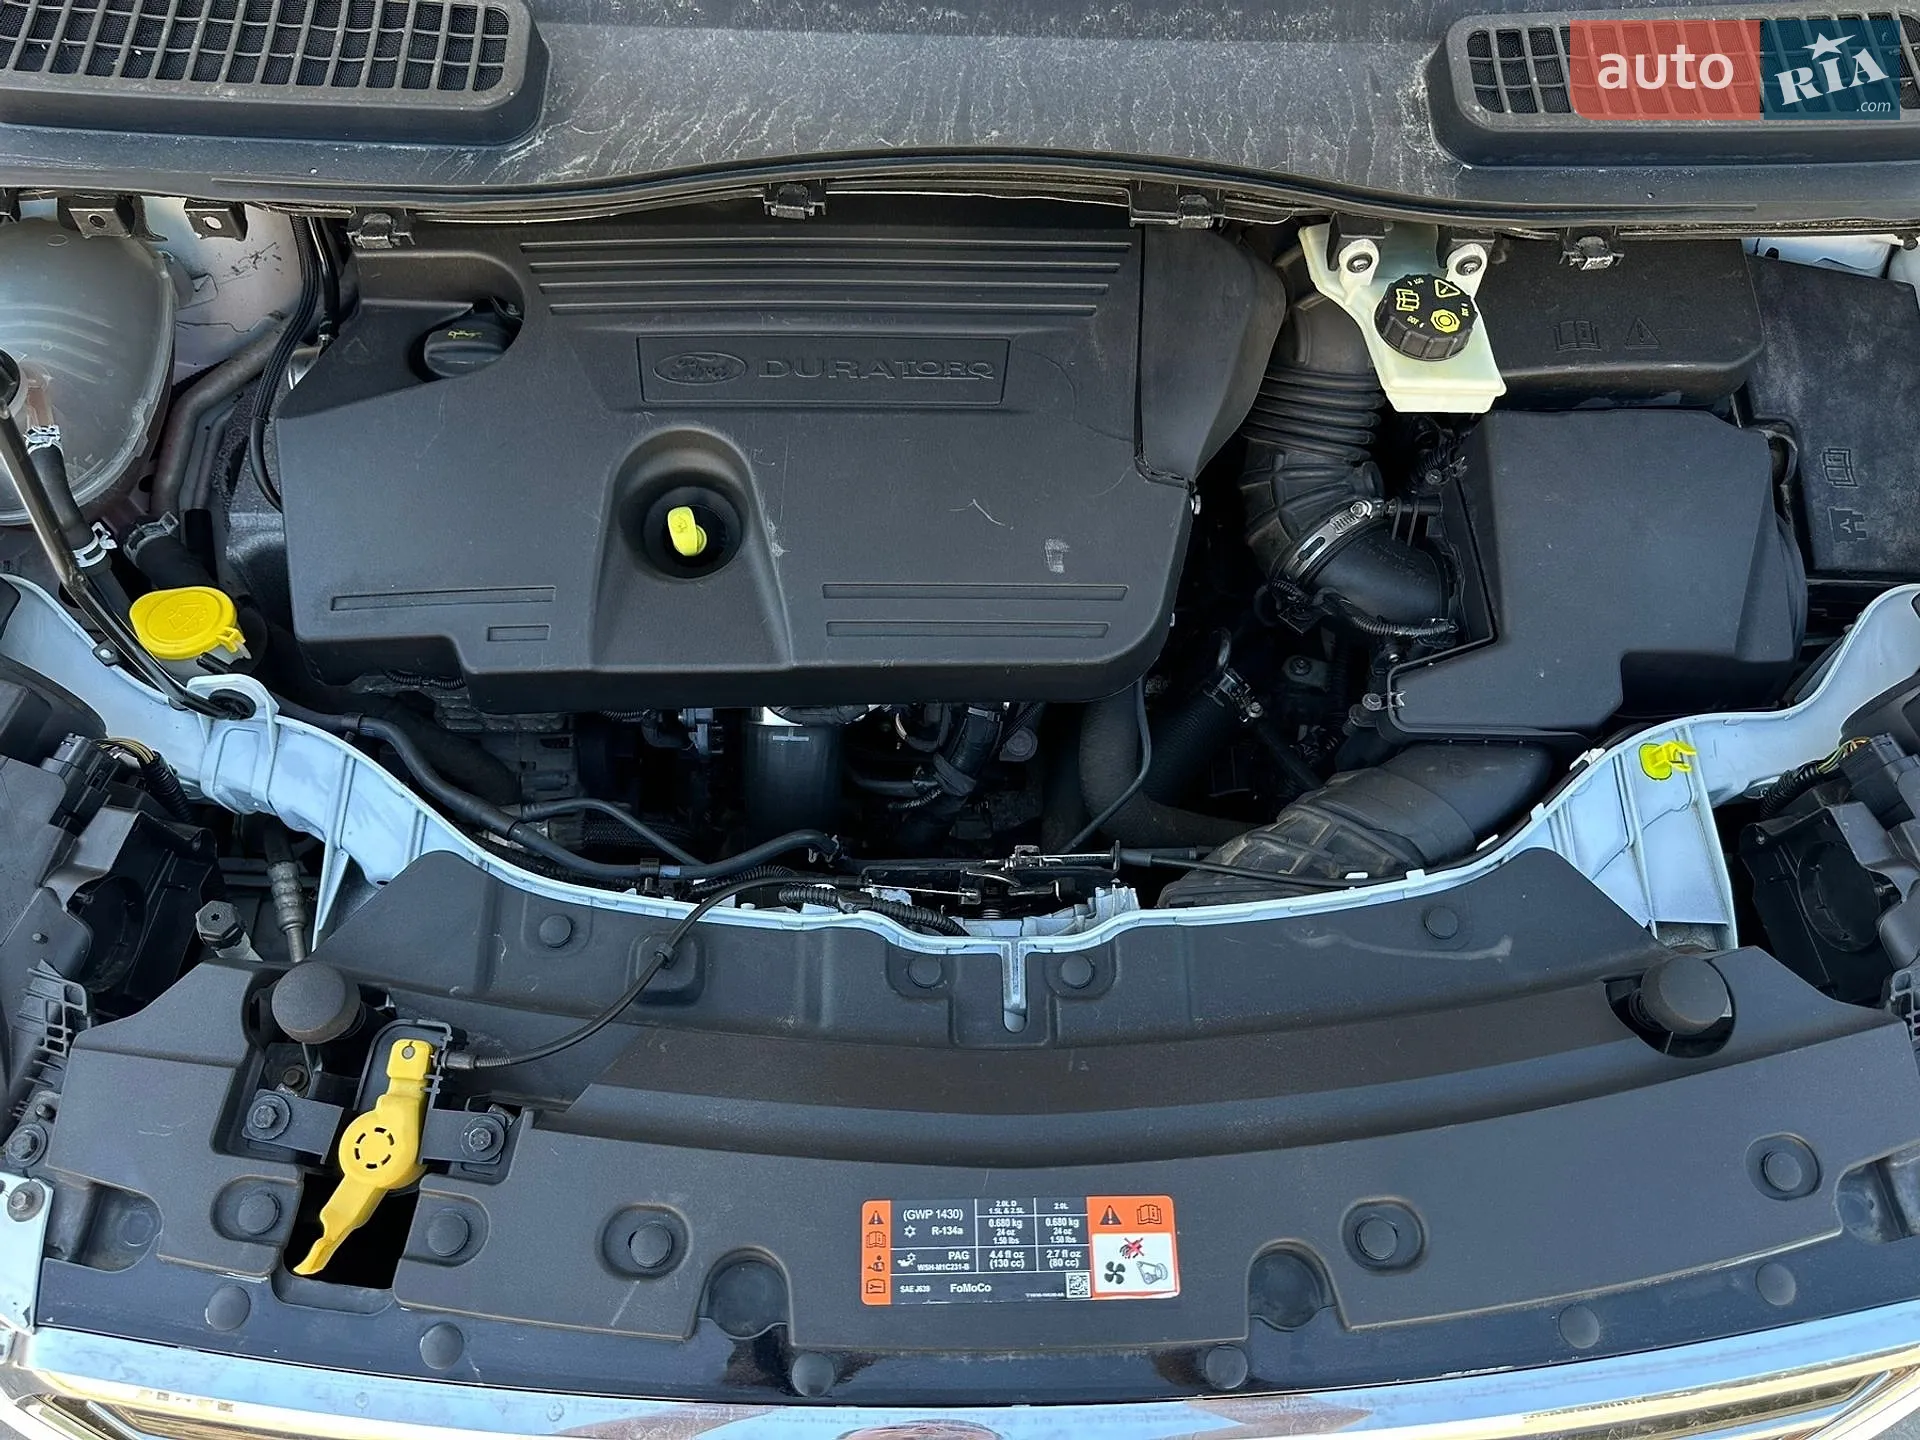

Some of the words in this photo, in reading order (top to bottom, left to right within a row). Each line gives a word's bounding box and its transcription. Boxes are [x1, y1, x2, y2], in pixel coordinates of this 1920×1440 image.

[759, 358, 994, 380] DURATORQ
[903, 1209, 933, 1221] (GWP
[936, 1208, 963, 1220] 1430)
[1012, 1218, 1023, 1229] kg
[1068, 1217, 1080, 1228] kg
[931, 1226, 964, 1235] R-134a
[948, 1251, 970, 1260] PAG
[989, 1250, 1004, 1258] 4.4
[1046, 1249, 1060, 1258] 2.7
[1070, 1250, 1082, 1258] oz
[989, 1258, 1009, 1269] (130
[1010, 1258, 1025, 1269] cc)
[1064, 1257, 1079, 1268] cc)
[900, 1285, 914, 1293] SAE
[949, 1283, 992, 1293] FoMoCo
